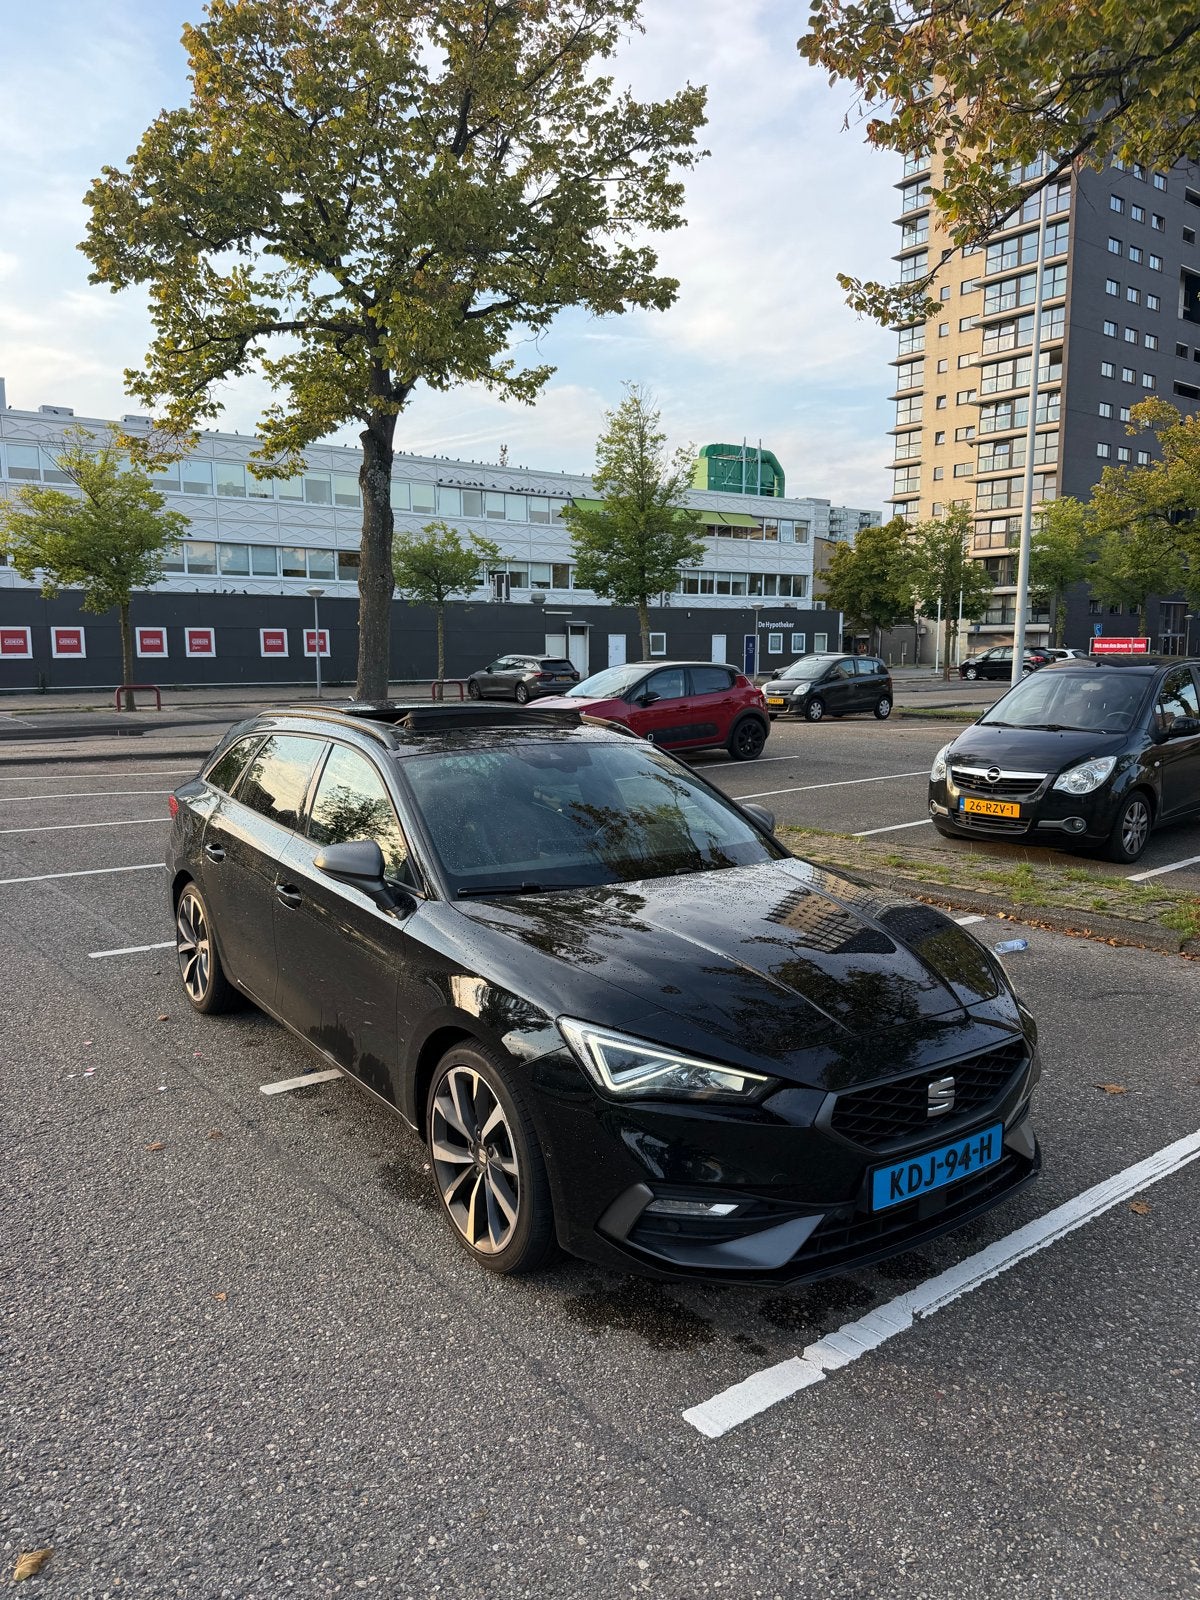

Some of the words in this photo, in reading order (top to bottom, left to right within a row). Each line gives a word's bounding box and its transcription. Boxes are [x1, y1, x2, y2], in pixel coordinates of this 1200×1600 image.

[766, 621, 795, 629] Hypotheker
[969, 800, 1014, 815] 26-RZV-1
[890, 1133, 993, 1200] KDJ-94-H
